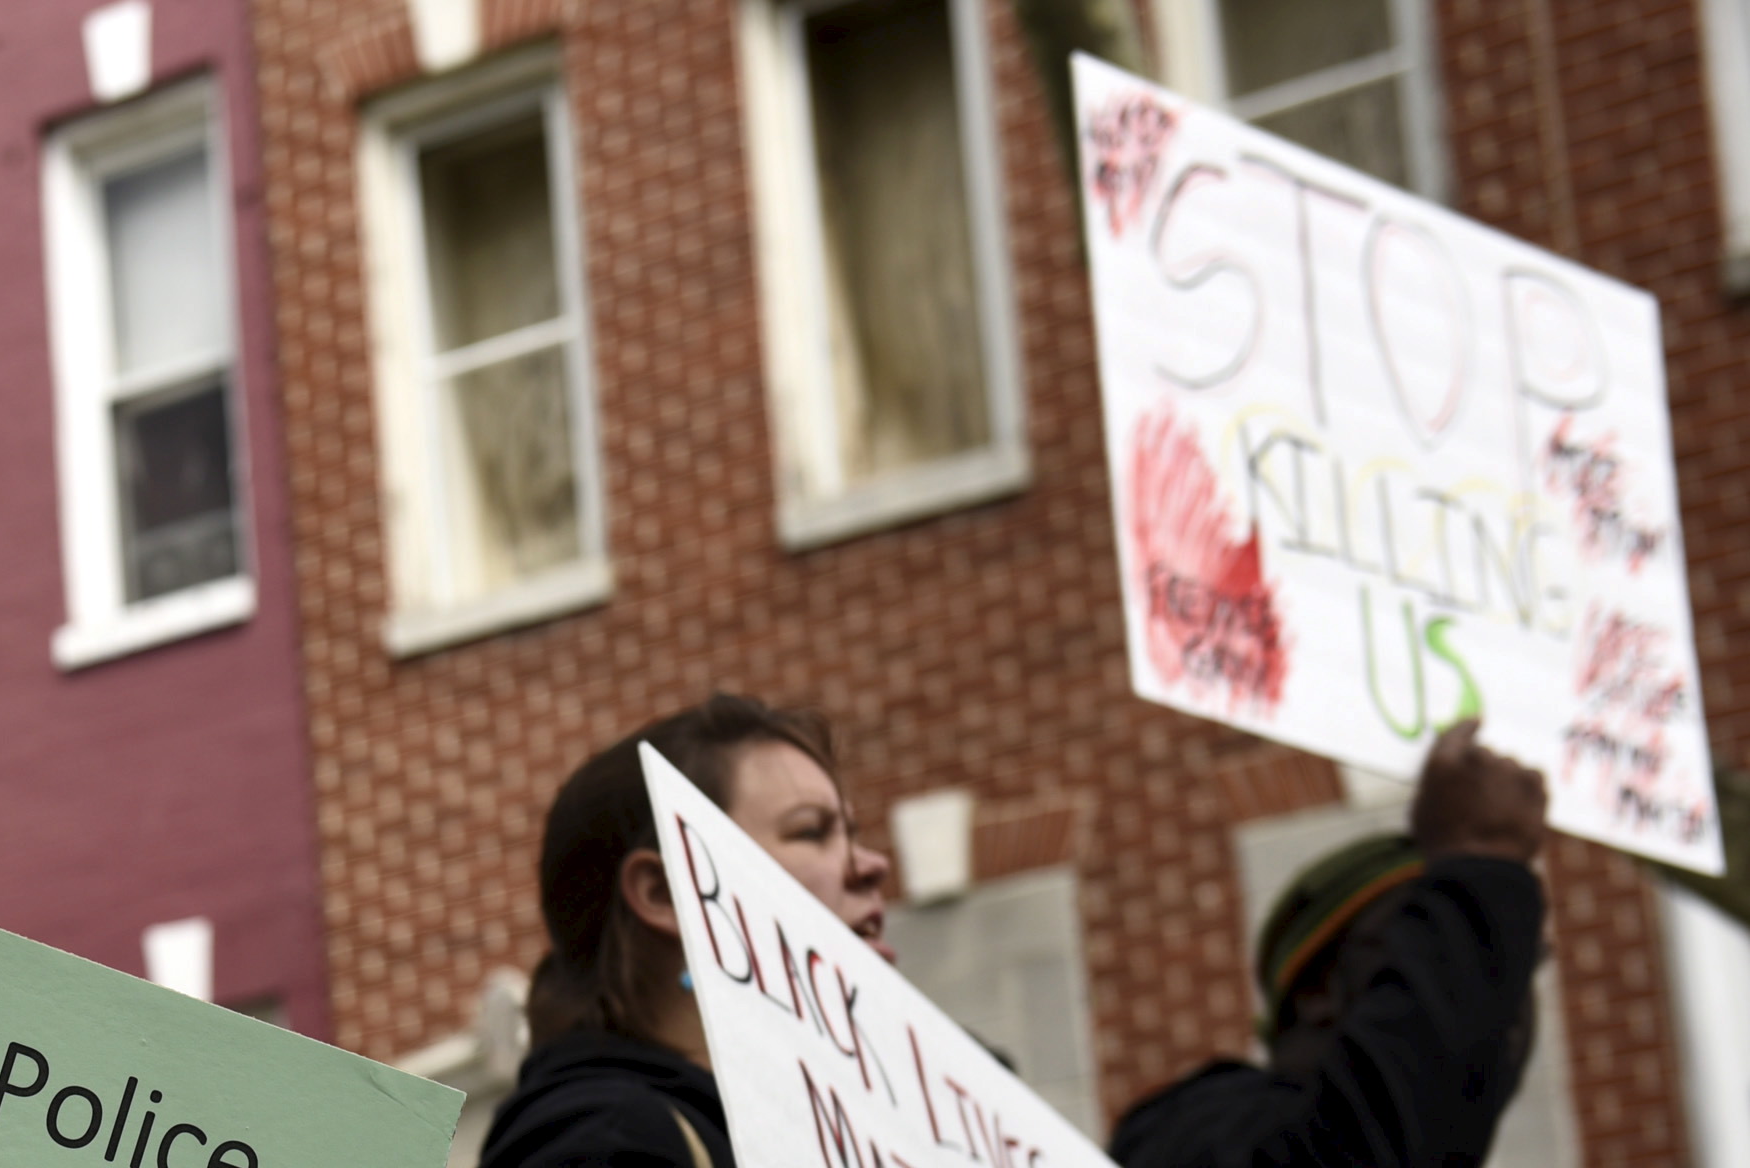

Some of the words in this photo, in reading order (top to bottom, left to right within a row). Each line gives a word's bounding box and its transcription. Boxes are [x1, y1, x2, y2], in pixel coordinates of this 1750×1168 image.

[1148, 152, 1606, 492] STOP
[1230, 414, 1570, 638] KILLING
[1360, 582, 1486, 740] US
[674, 812, 896, 1107] BLACK
